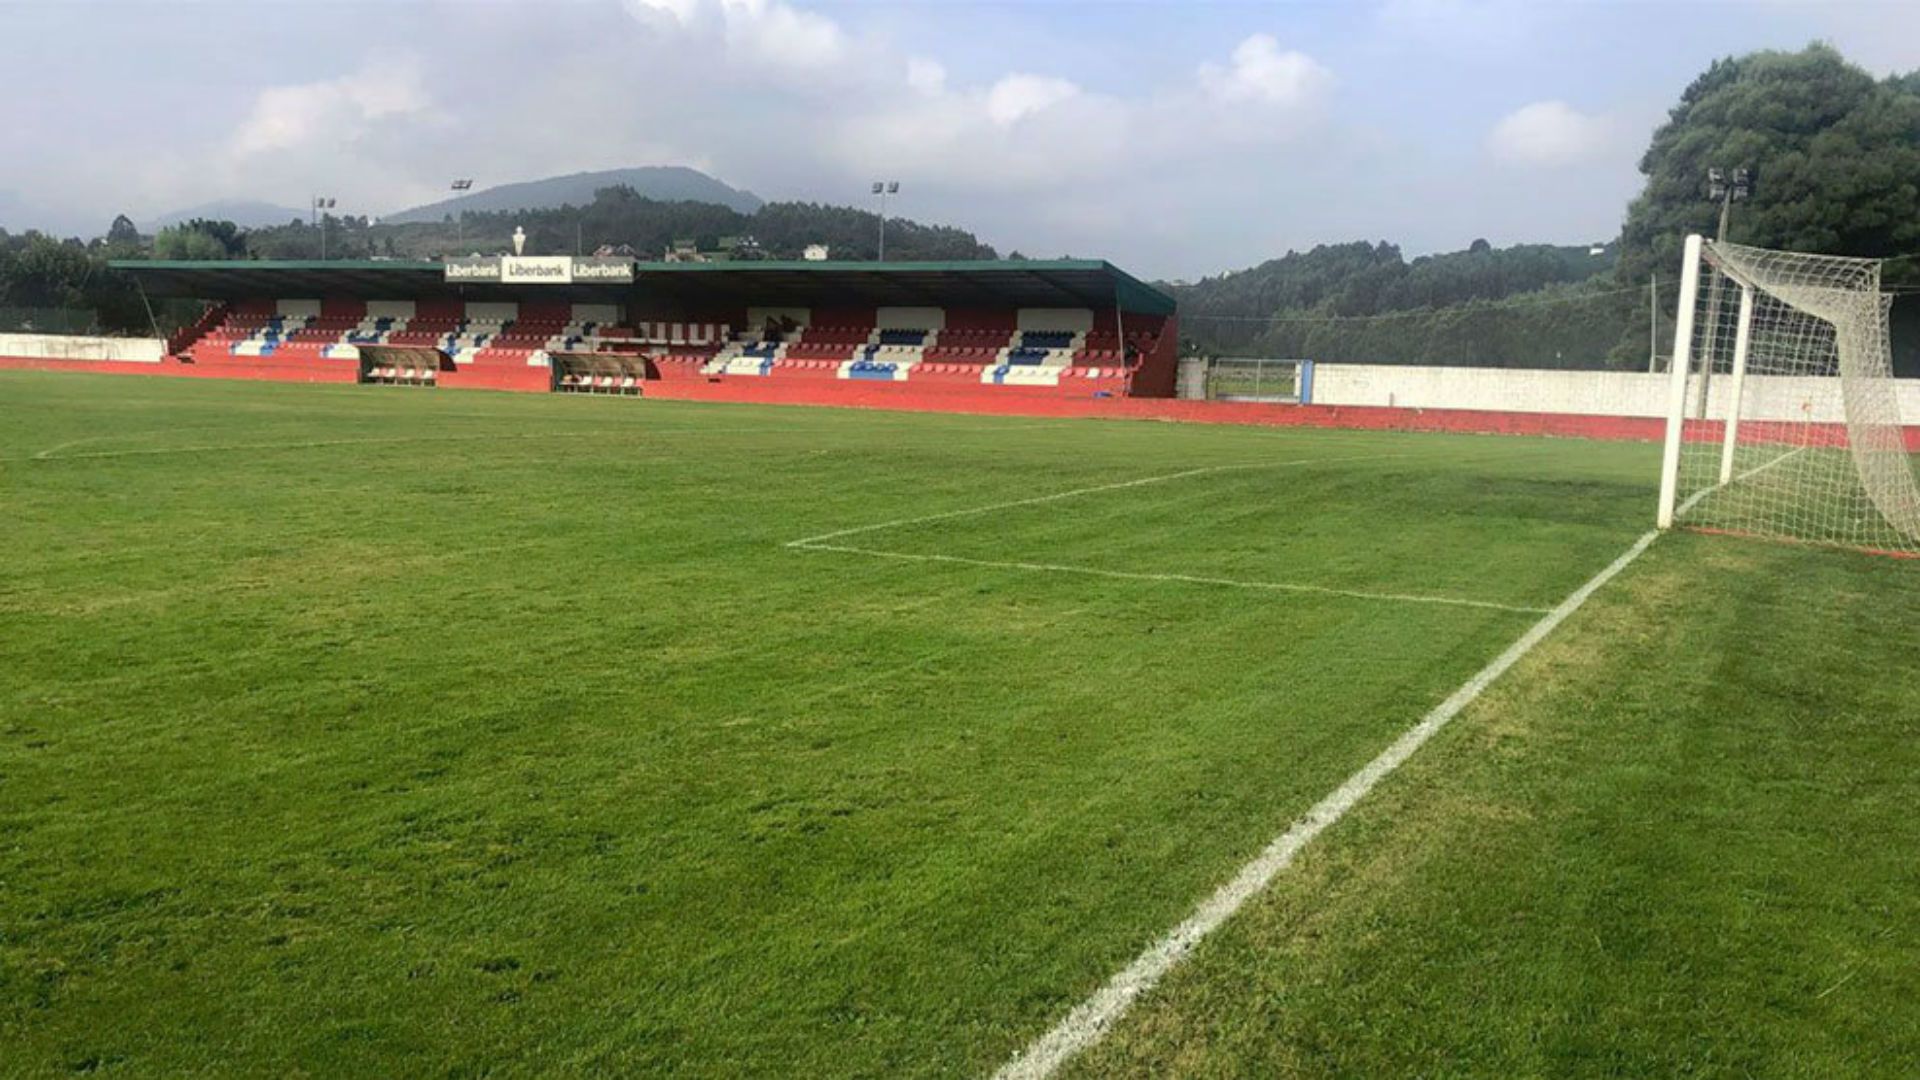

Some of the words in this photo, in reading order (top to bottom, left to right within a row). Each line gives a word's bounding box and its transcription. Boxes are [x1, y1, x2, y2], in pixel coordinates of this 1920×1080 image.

[447, 263, 499, 277] Liberbank
[509, 263, 565, 277] Liberbank
[573, 263, 632, 277] Liberbank
